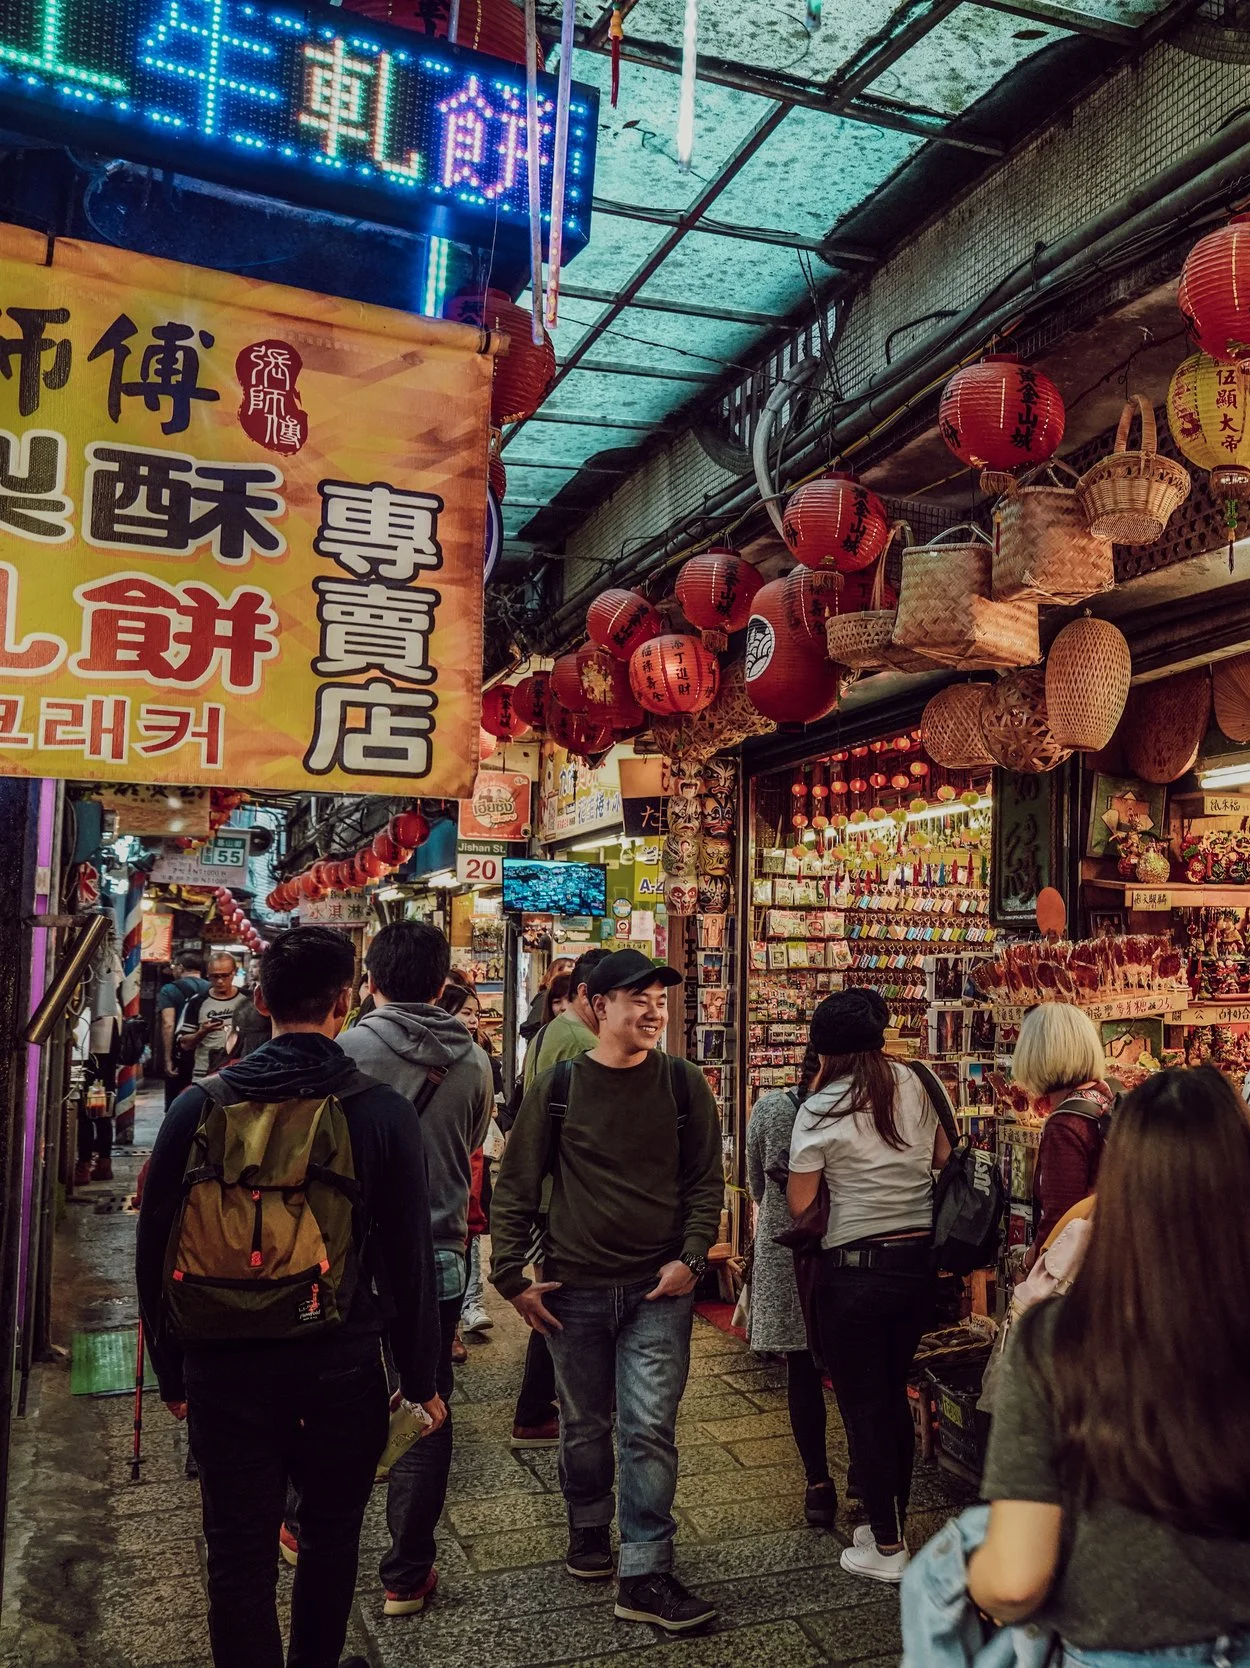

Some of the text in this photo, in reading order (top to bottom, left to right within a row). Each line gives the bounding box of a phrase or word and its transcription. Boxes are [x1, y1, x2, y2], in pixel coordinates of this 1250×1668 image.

[1010, 367, 1041, 452] 黃金山城
[304, 481, 443, 777] 專賣店
[218, 850, 240, 864] 55
[458, 843, 490, 853] Jishan
[466, 858, 496, 880] 20
